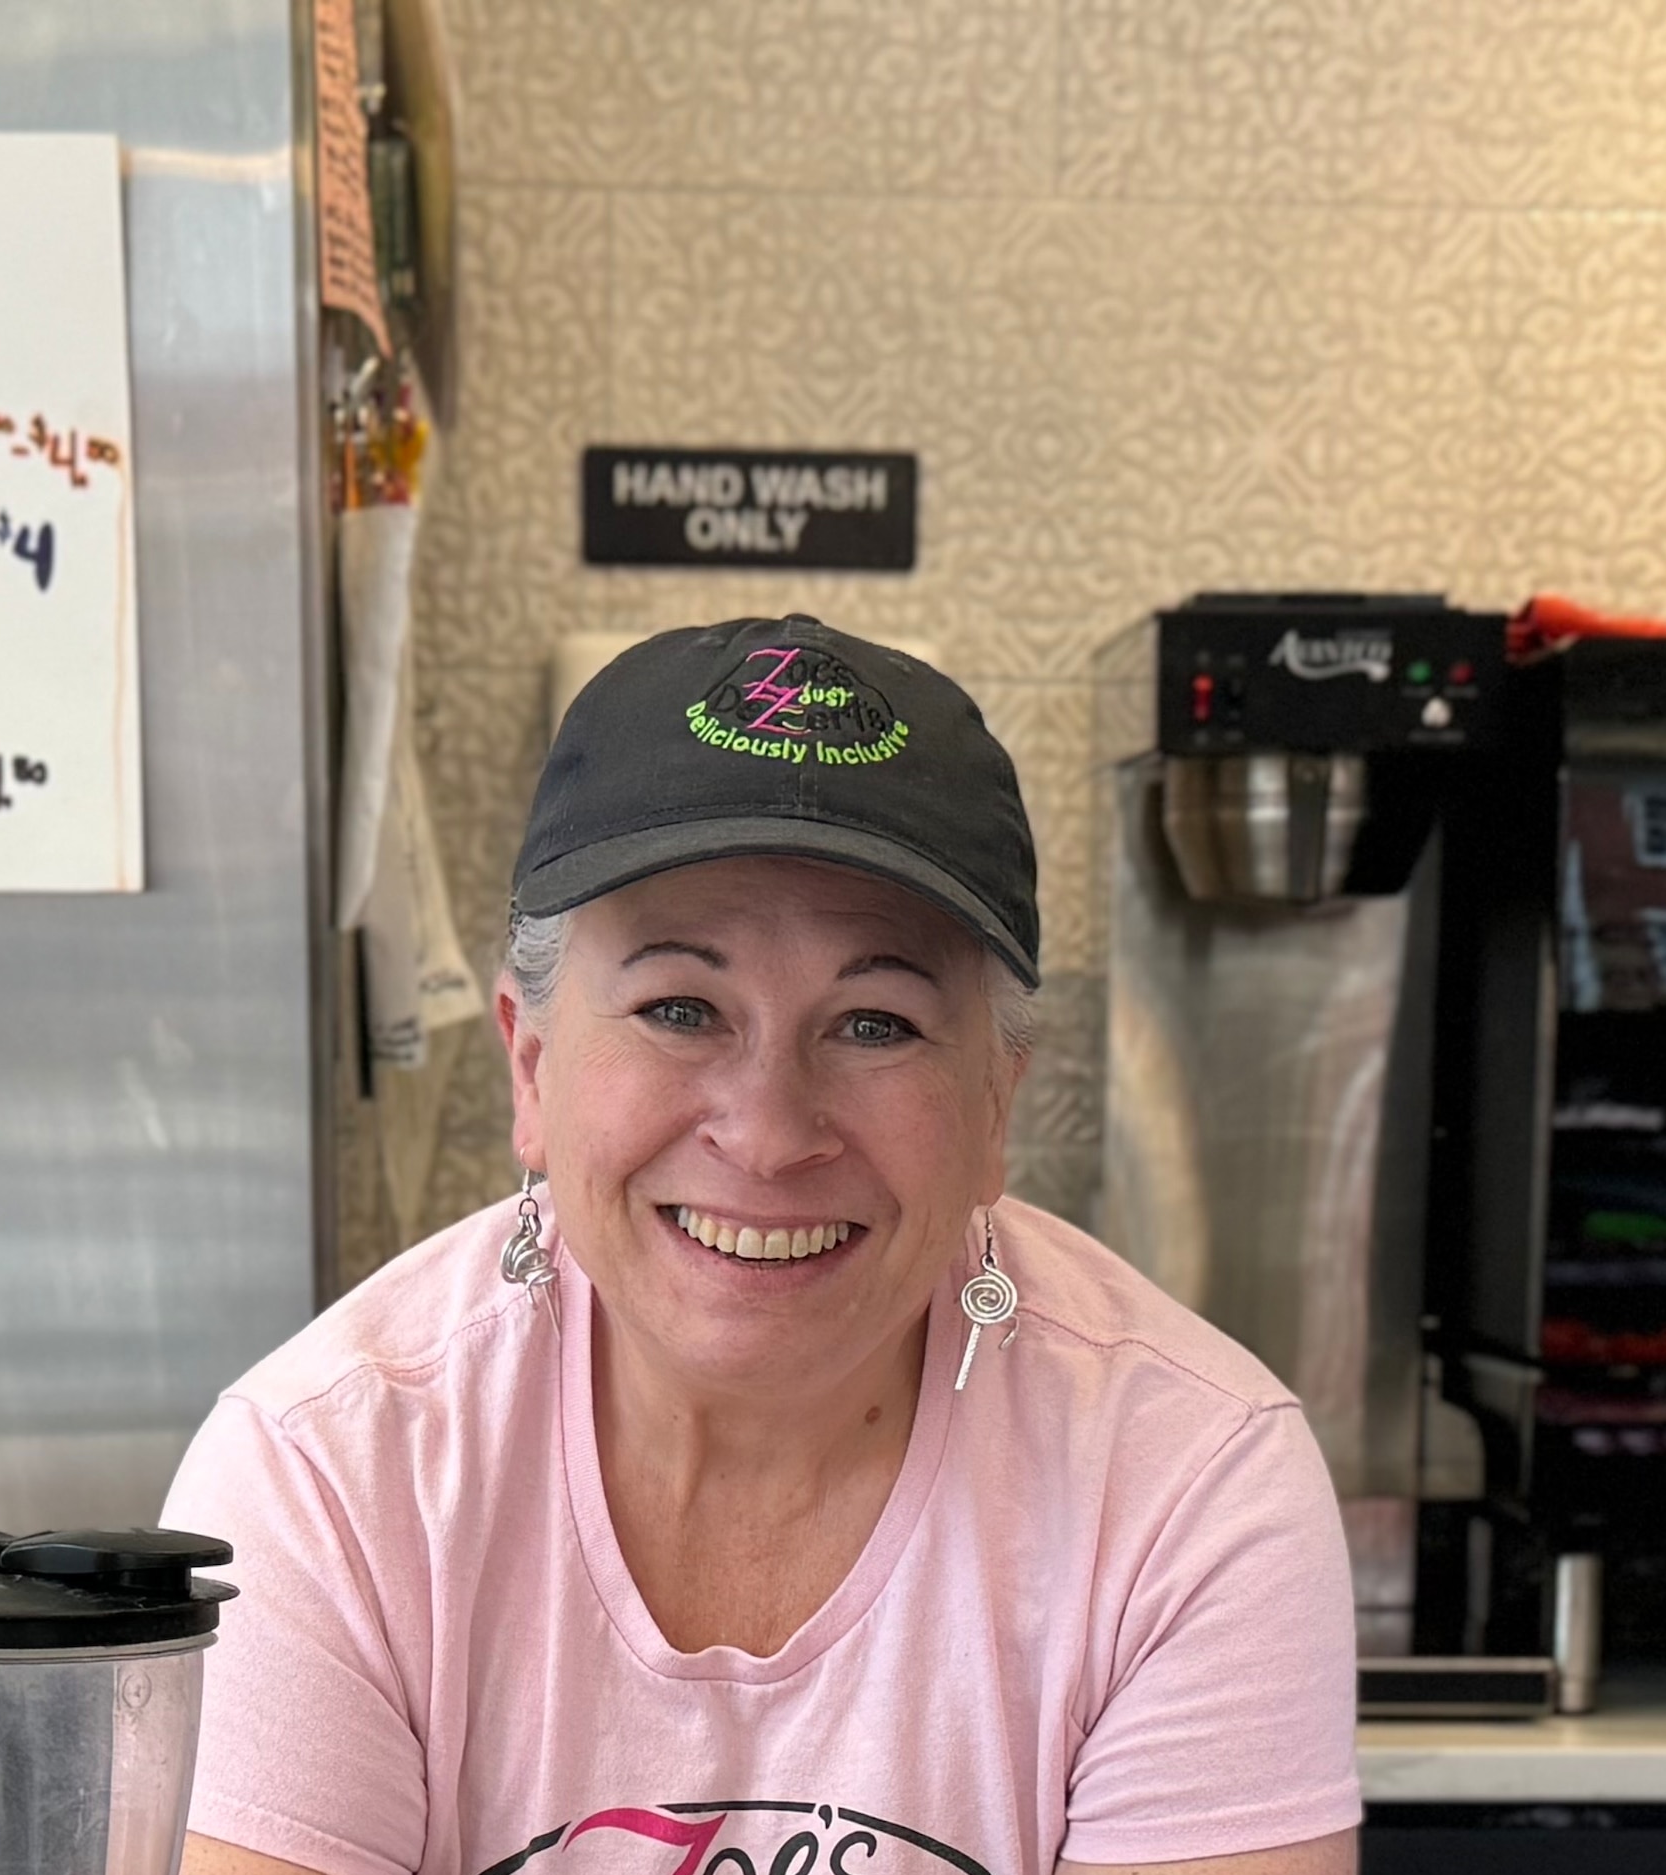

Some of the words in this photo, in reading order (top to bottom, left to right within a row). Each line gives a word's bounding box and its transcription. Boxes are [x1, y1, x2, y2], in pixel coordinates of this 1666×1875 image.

[613, 463, 744, 507] HAND
[750, 465, 888, 511] WASH
[685, 508, 808, 552] ONLY
[686, 700, 807, 764] Deliciously
[817, 720, 910, 765] Inclusive
